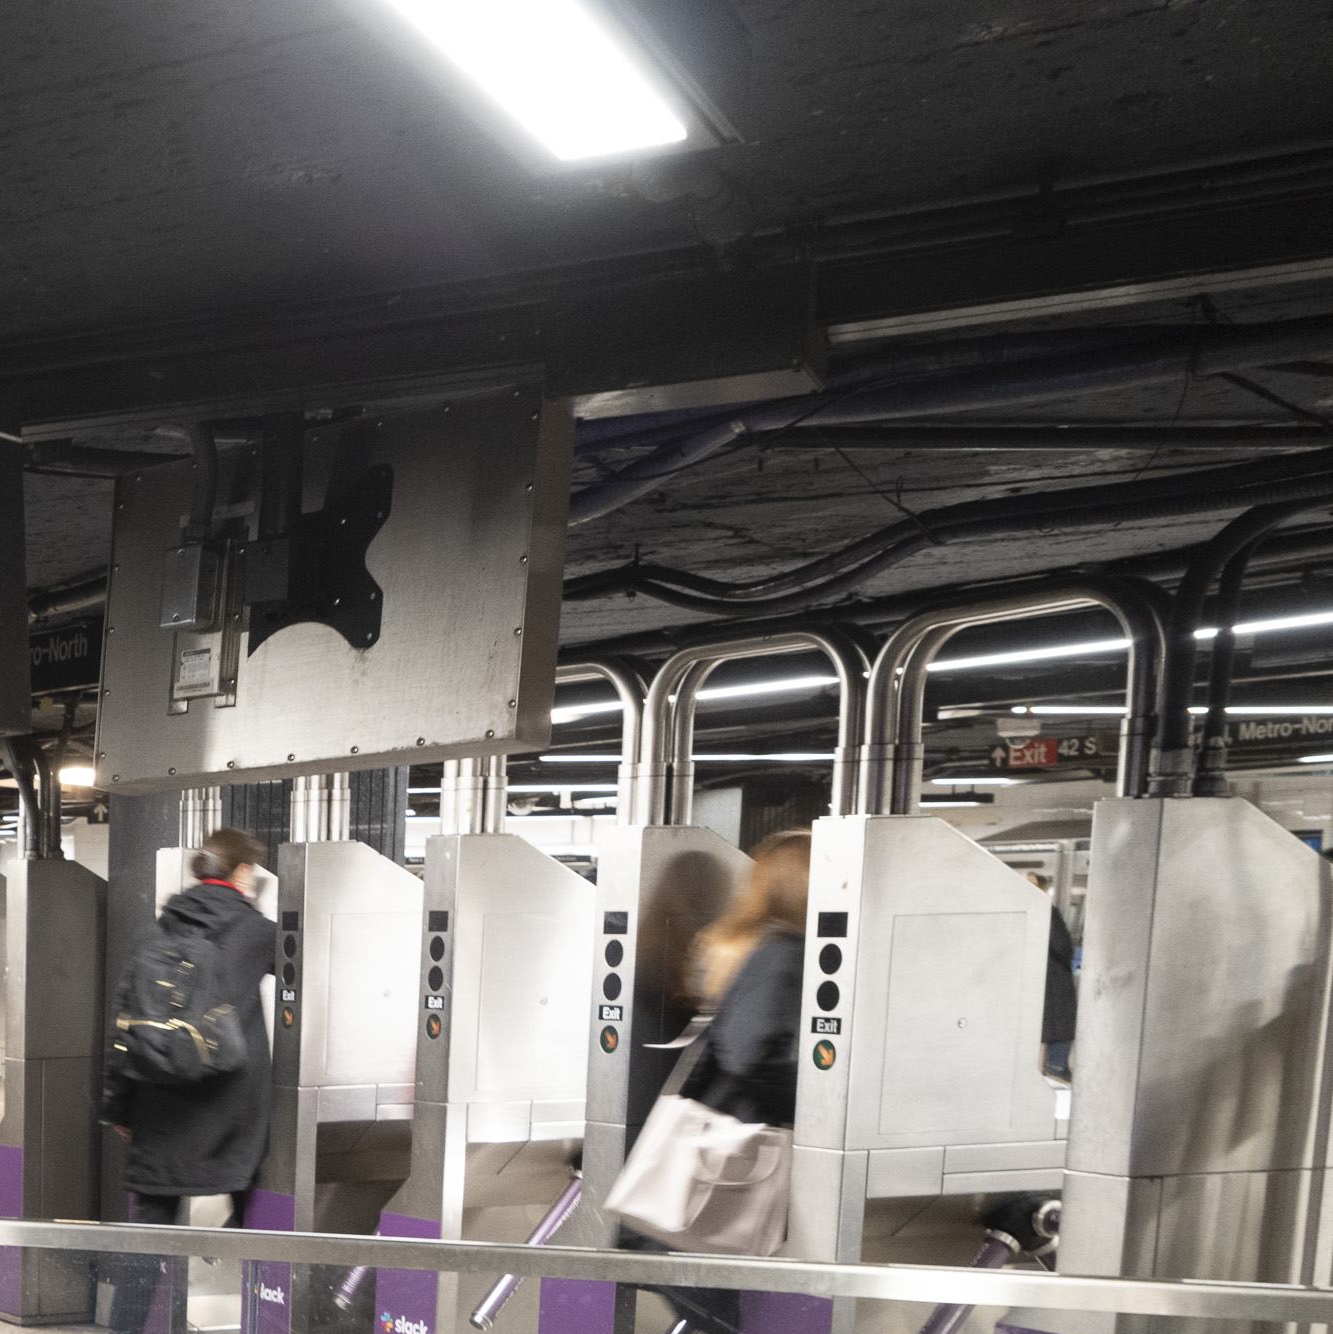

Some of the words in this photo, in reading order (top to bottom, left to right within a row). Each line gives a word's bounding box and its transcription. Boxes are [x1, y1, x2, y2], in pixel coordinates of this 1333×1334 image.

[32, 632, 89, 666] o-North
[1239, 717, 1333, 741] Metro-Nor
[1009, 743, 1047, 765] Exit
[1058, 738, 1080, 756] 42
[1083, 736, 1097, 755] S
[282, 989, 296, 1001] Exit
[427, 996, 443, 1009] Exit
[602, 1005, 620, 1020] Exit
[816, 1018, 838, 1033] Exit
[260, 1283, 285, 1305] lack
